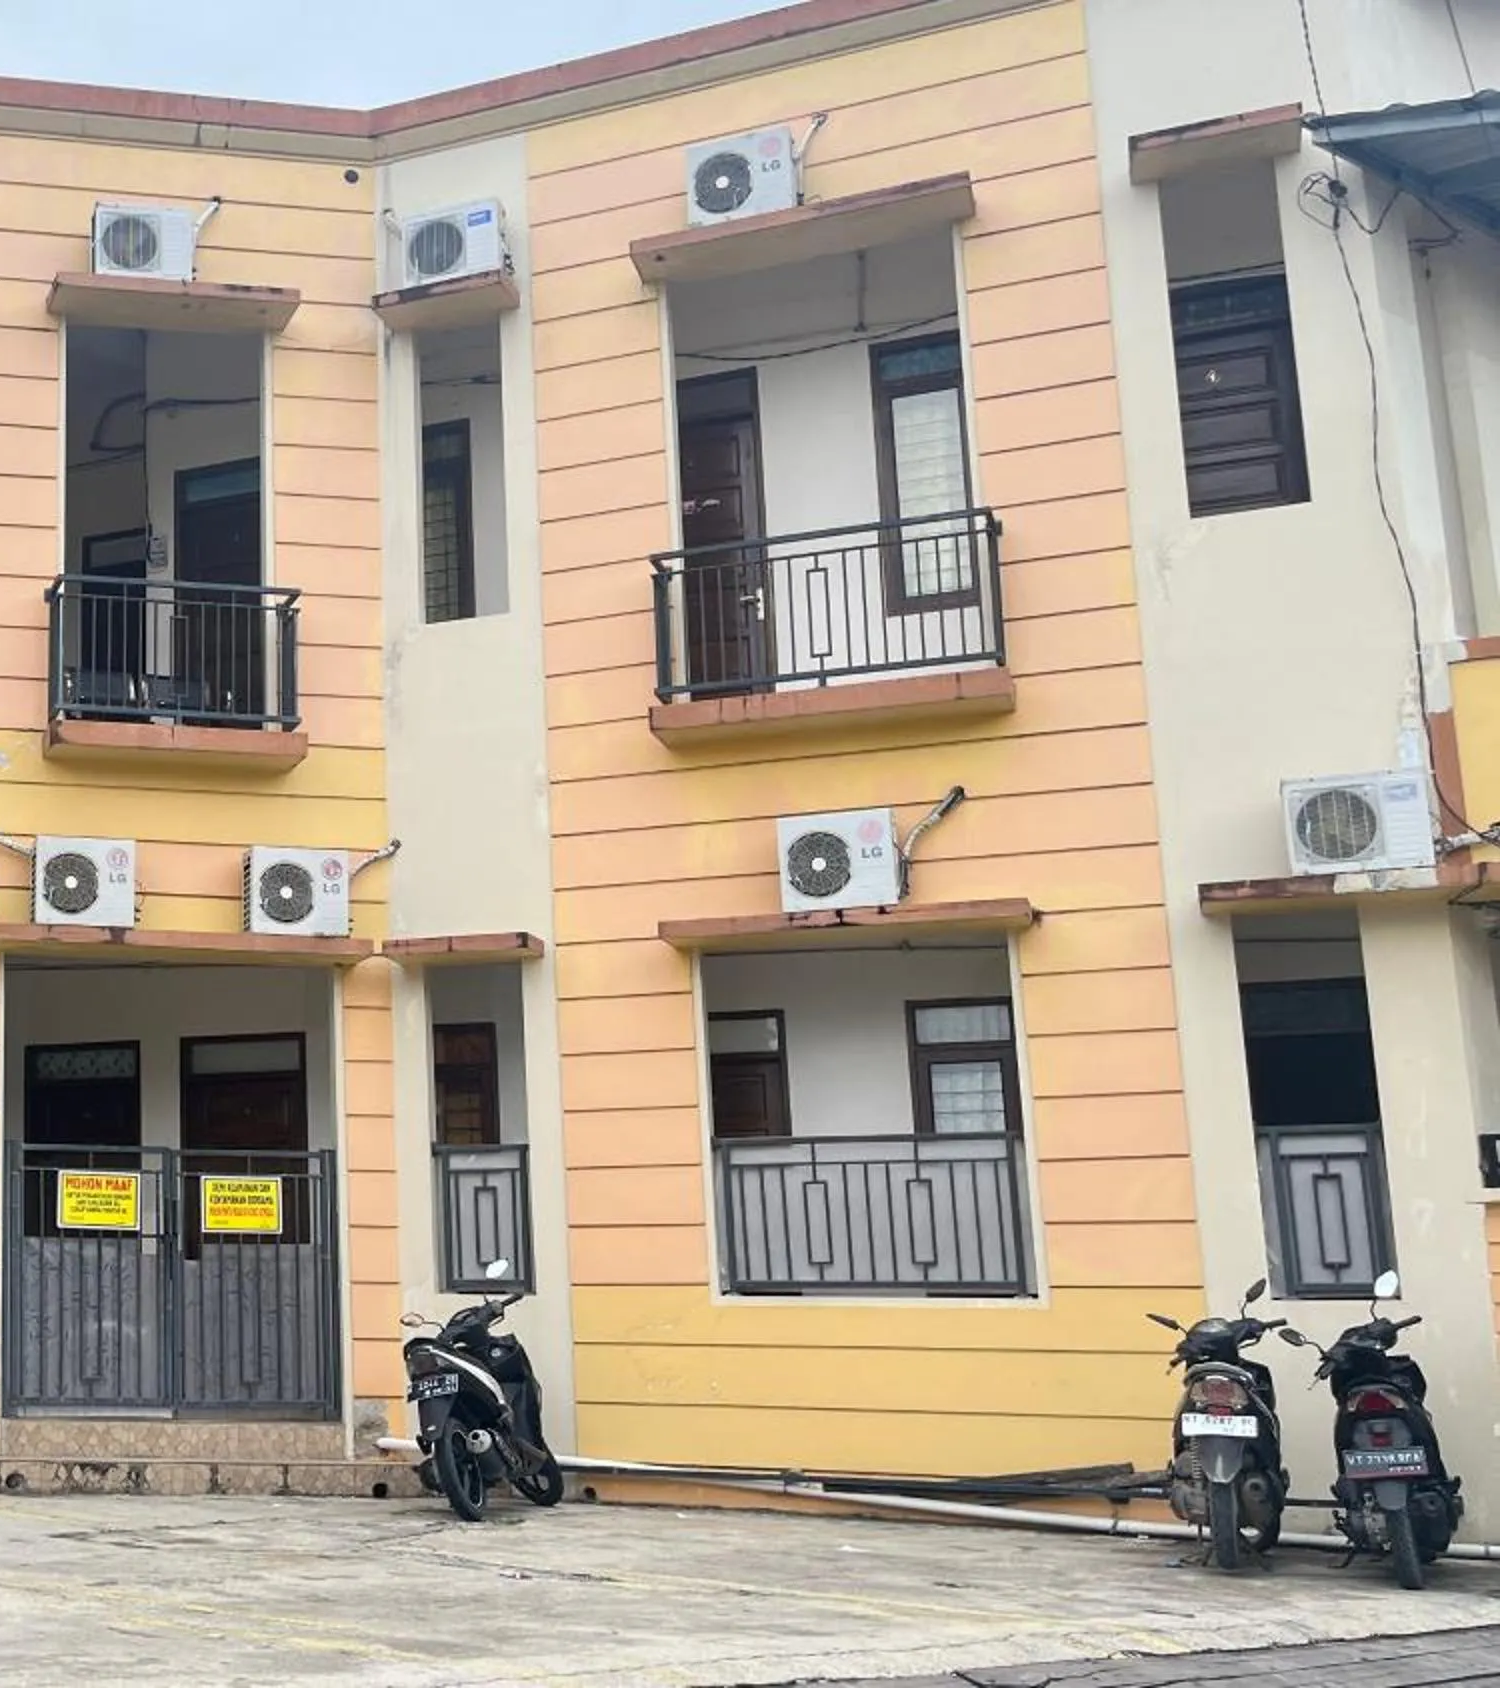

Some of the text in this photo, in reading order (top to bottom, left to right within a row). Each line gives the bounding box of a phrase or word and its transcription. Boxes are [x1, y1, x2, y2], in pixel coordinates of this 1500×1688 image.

[762, 160, 781, 172] LG
[861, 846, 884, 859] LG
[109, 872, 127, 883] LG
[323, 883, 341, 894] LG
[66, 1176, 133, 1192] MOHON MAAF
